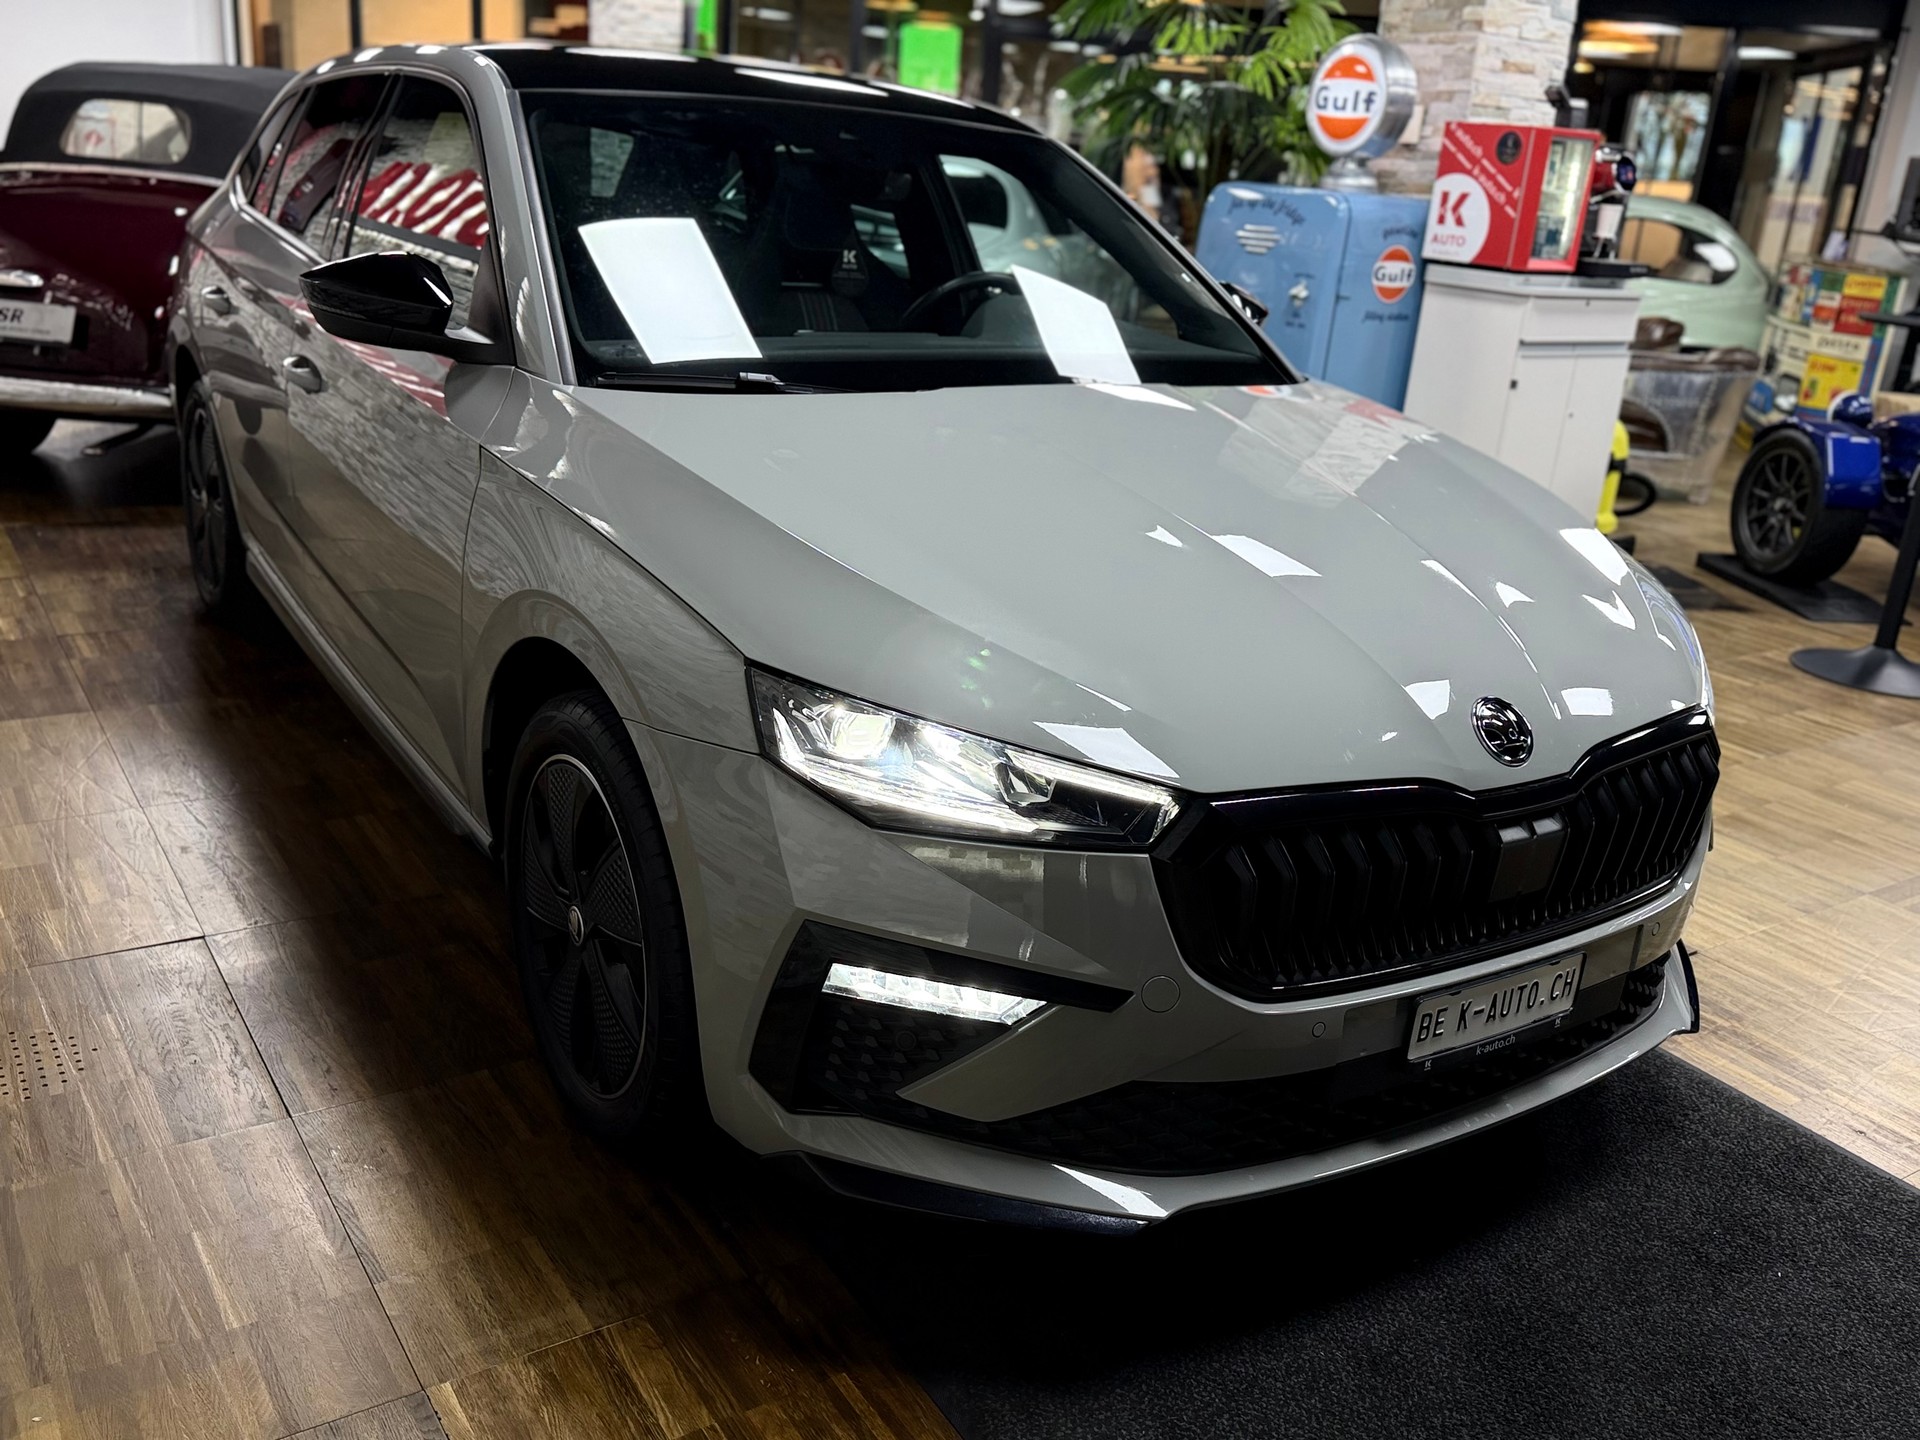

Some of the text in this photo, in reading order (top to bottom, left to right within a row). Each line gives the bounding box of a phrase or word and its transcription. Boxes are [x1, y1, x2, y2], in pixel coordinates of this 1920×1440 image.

[1315, 86, 1378, 113] Gulf
[1437, 191, 1470, 228] K
[1431, 234, 1466, 247] AUTO
[1373, 265, 1415, 284] Gulf
[1416, 967, 1577, 1043] BE K-AUTO.CH
[1476, 1034, 1516, 1055] k-auto.ch
